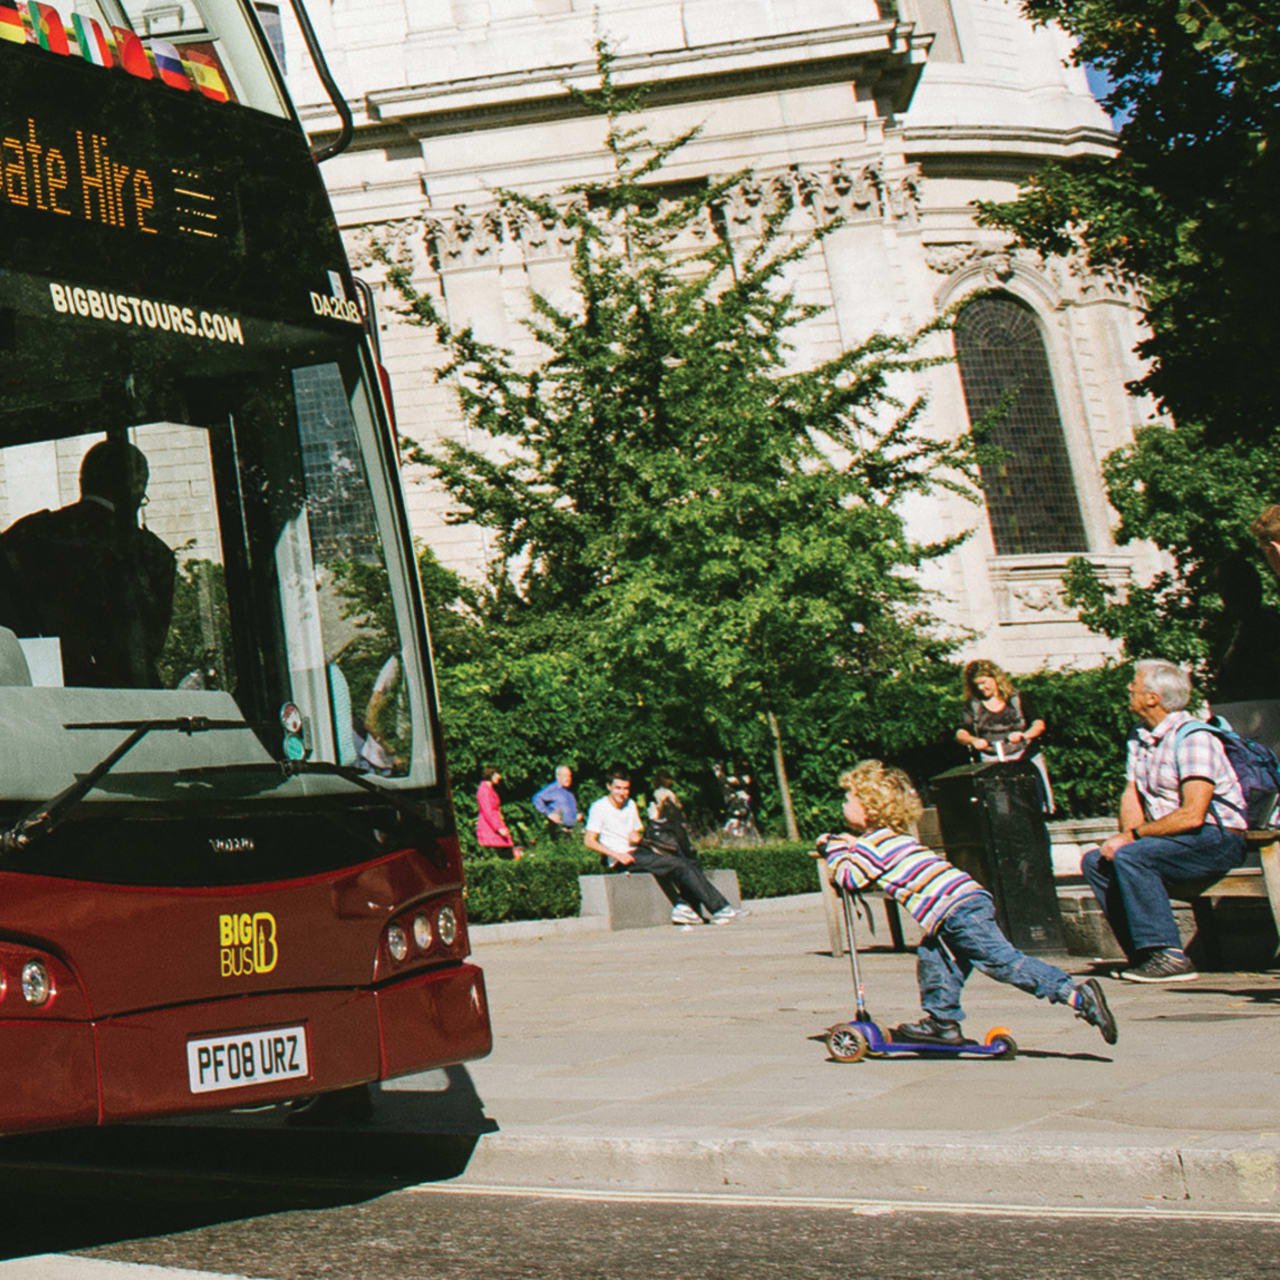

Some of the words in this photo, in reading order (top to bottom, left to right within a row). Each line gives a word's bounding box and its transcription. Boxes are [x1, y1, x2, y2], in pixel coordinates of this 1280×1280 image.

[76, 130, 158, 234] Hire
[49, 282, 244, 345] BIGBUSTOURS.COM
[310, 291, 362, 324] DA208
[219, 913, 252, 946] BIG
[220, 946, 254, 977] BUS
[197, 1041, 255, 1084] PF08
[260, 1035, 299, 1075] URZ
